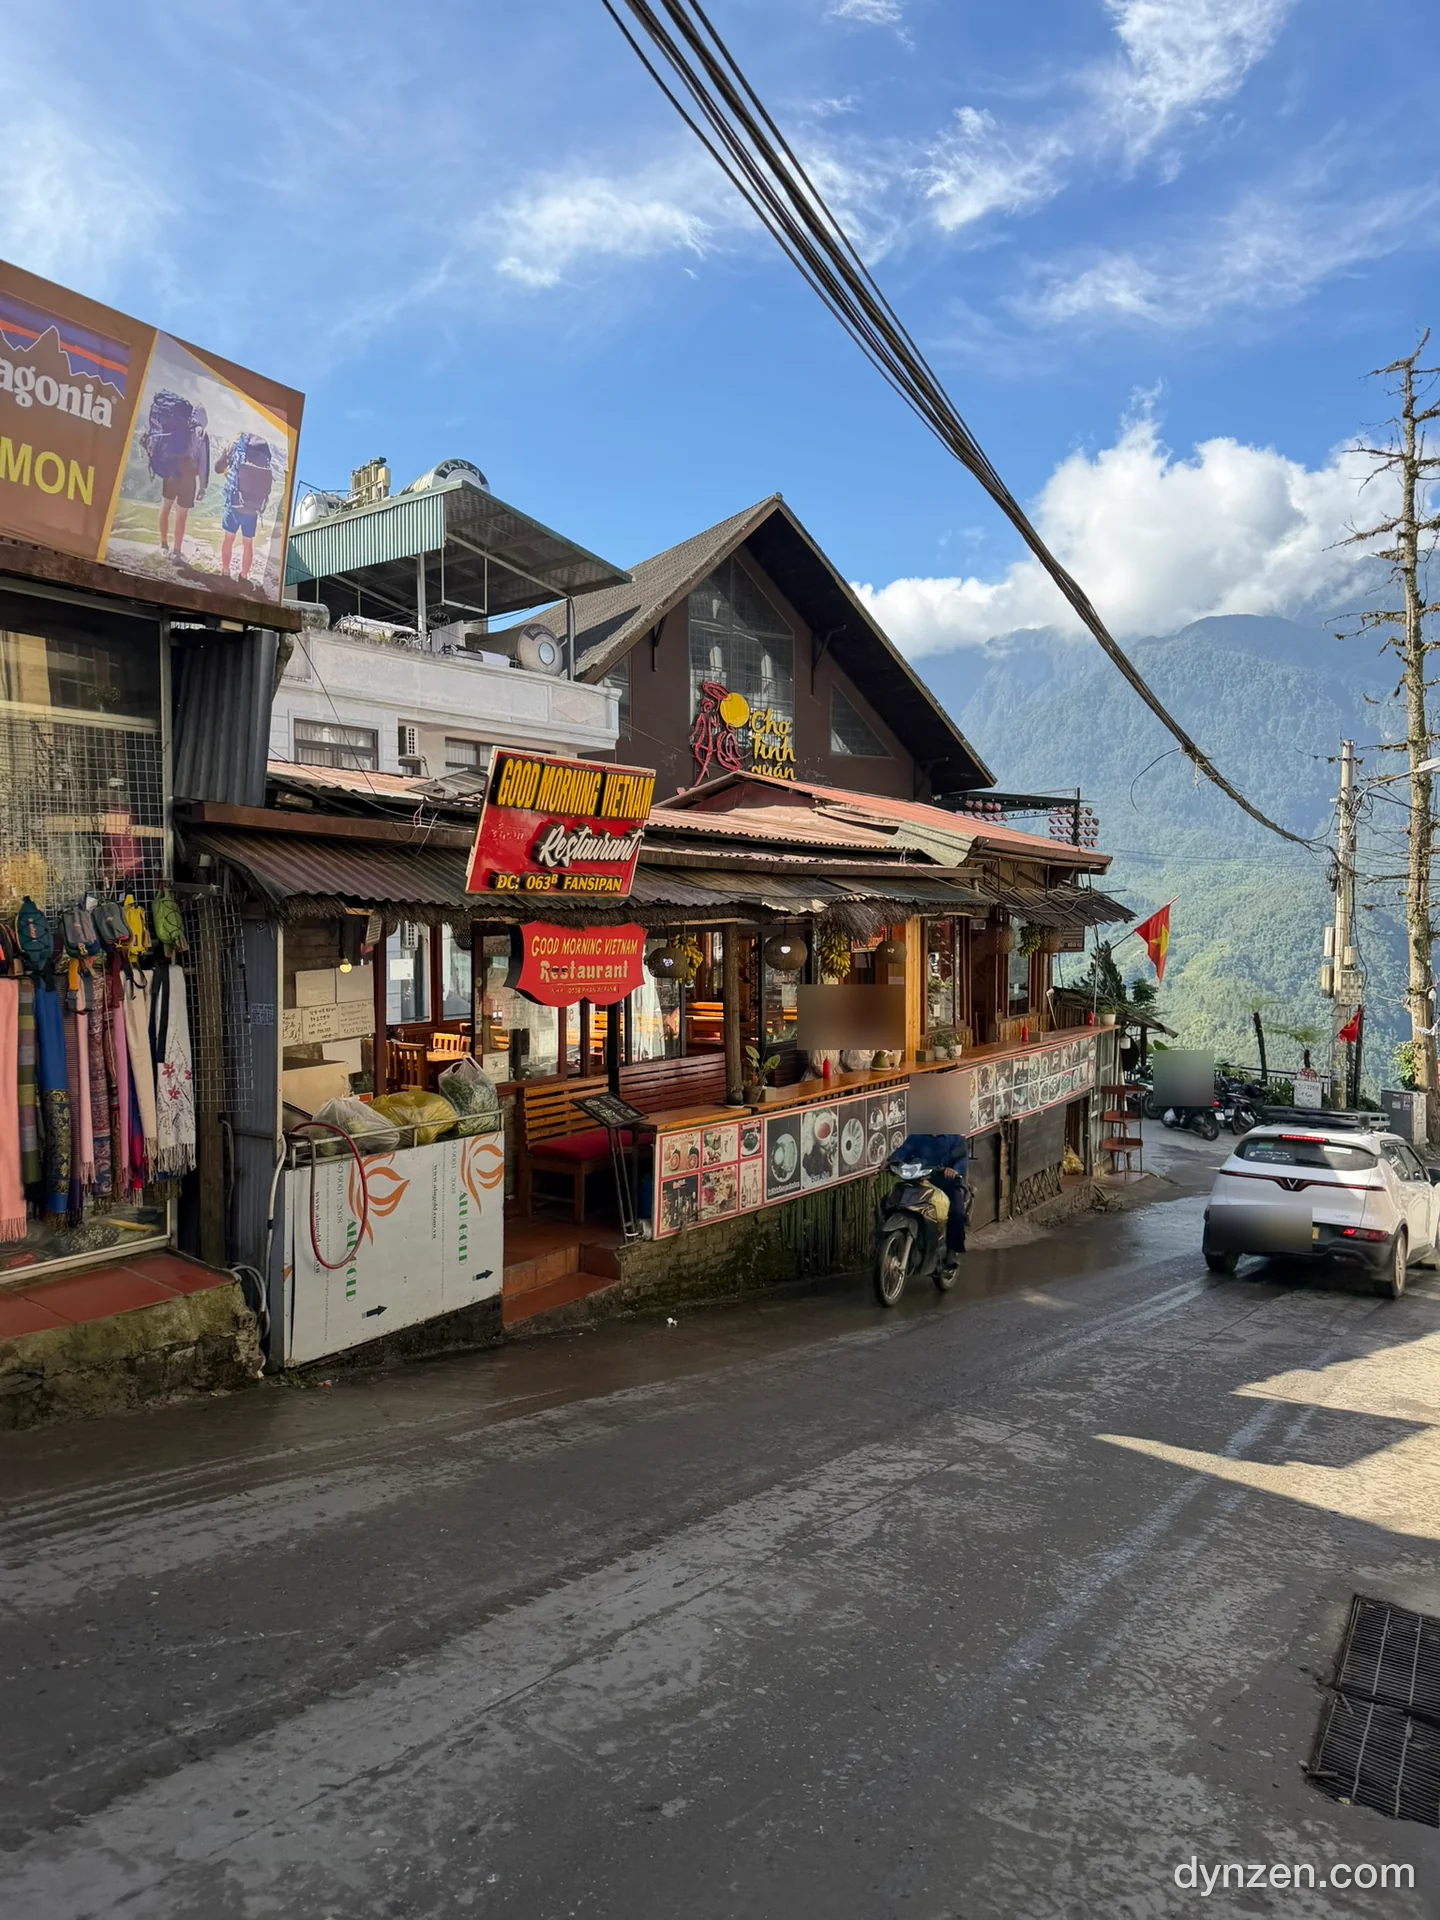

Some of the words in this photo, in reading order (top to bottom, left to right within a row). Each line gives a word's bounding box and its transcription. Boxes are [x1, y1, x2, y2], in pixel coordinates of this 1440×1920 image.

[498, 758, 541, 808] GOOD
[535, 765, 602, 815] MORNING
[600, 773, 656, 819] VIETNAM
[539, 824, 645, 868] Restaurant
[563, 876, 623, 892] FANSIPAN
[531, 935, 560, 957] GOOD
[560, 937, 603, 956] MORNING
[604, 938, 639, 956] VIETNAM
[540, 960, 628, 983] Restaurant
